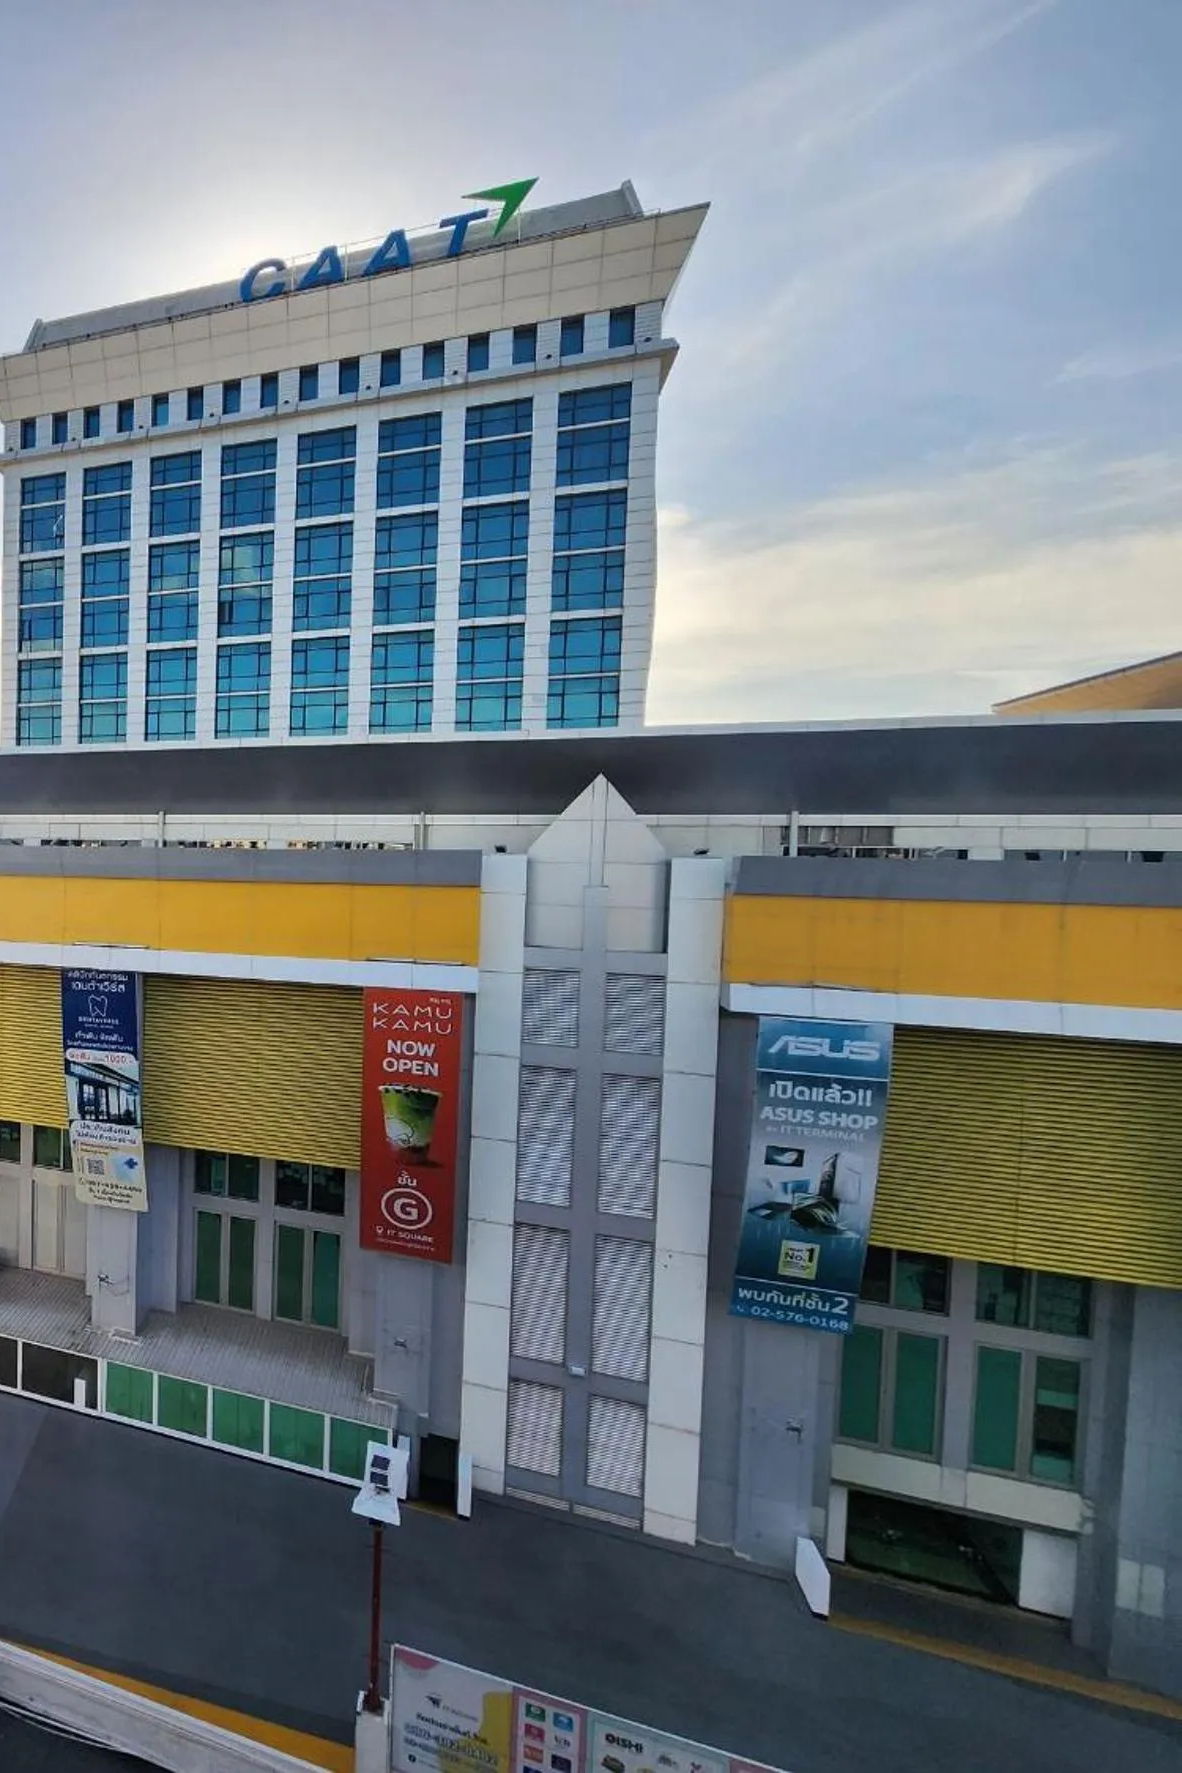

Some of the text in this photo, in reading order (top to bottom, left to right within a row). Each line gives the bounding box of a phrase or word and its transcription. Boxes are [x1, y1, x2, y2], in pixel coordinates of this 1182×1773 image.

[239, 208, 490, 303] CAAT
[373, 1002, 452, 1019] KAMU
[373, 1017, 452, 1035] KAMU
[387, 1039, 435, 1057] NOW
[768, 1035, 881, 1061] ASUS
[383, 1057, 439, 1076] OPEN
[768, 1080, 872, 1107] เปิดแล้ว!!
[760, 1105, 878, 1130] ASUS SHOP
[795, 1126, 866, 1142] TERMINAL
[397, 1170, 417, 1186] ชั้น
[394, 1198, 418, 1220] G
[386, 1229, 434, 1243] IT SQUARE
[750, 1306, 849, 1331] 02-576-0168
[605, 1732, 644, 1754] OISHI
